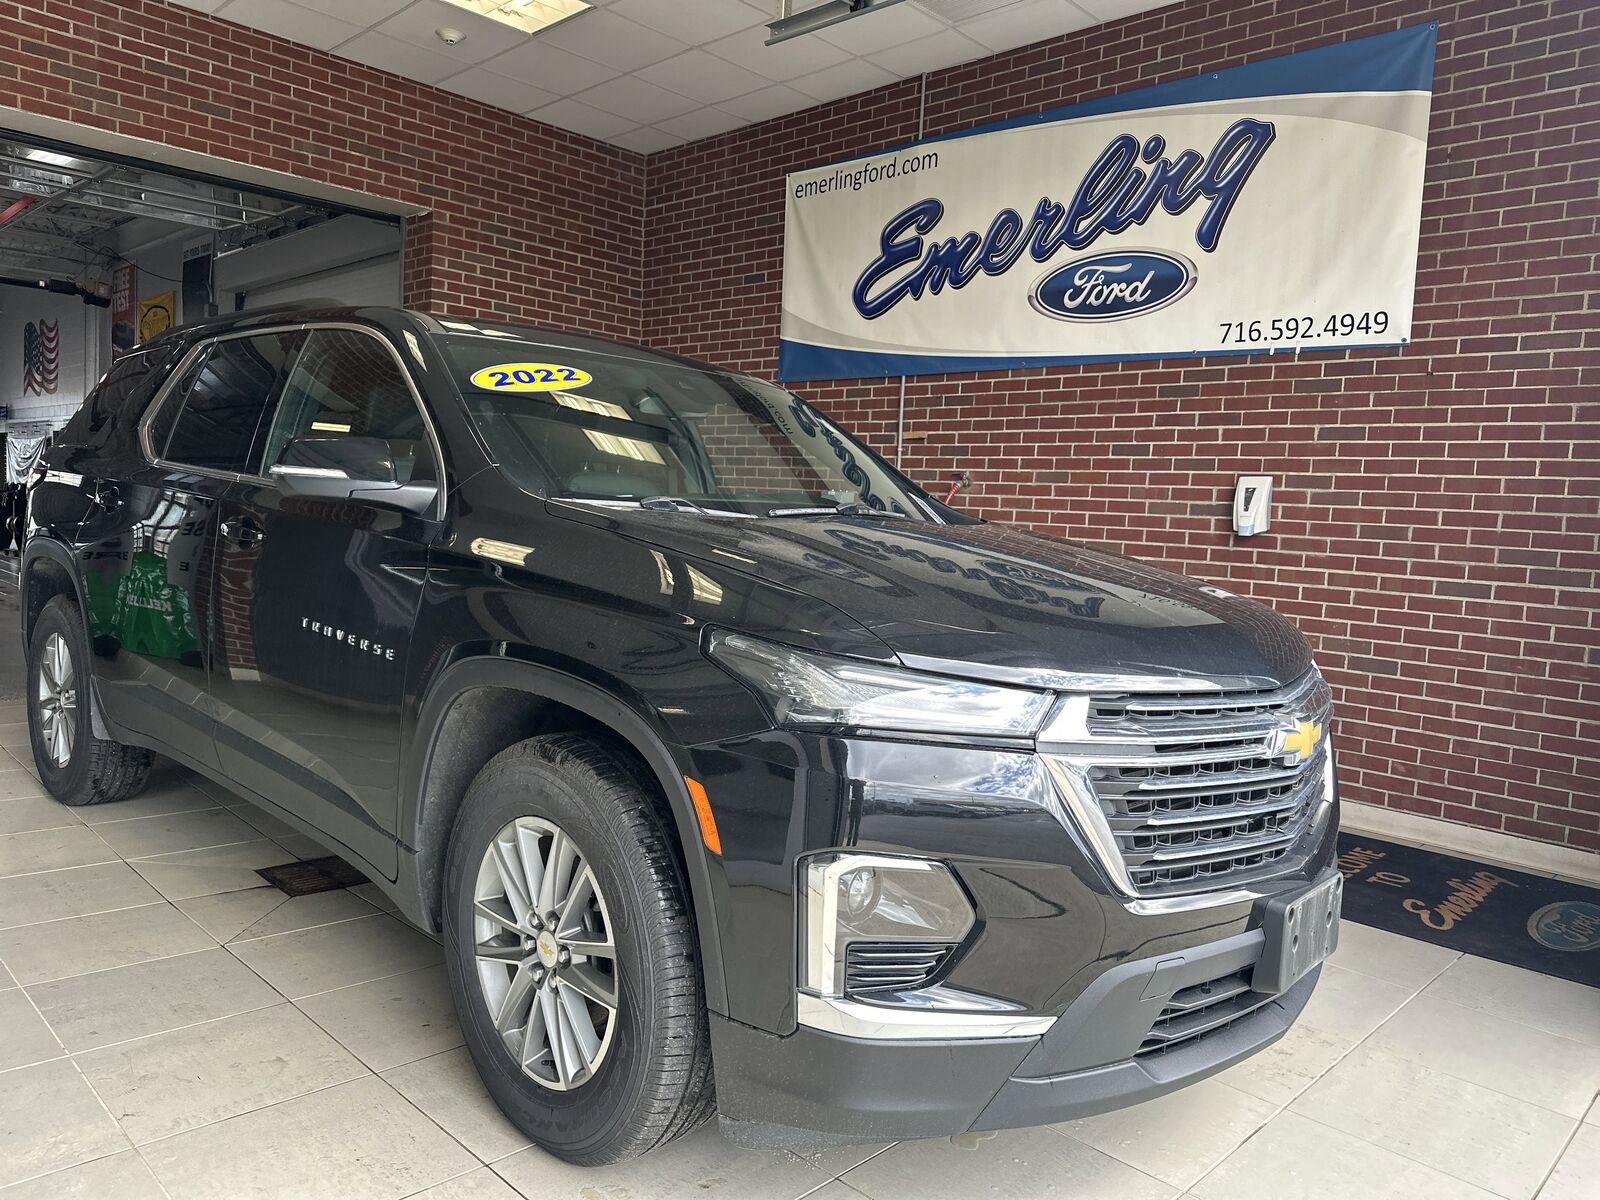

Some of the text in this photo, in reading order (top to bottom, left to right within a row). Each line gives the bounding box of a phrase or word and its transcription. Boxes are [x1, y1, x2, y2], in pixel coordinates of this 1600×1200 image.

[795, 151, 939, 199] emerlingford.com
[850, 117, 1277, 321] Emerling
[1063, 263, 1153, 309] Ford
[1219, 311, 1390, 345] 716.592.4949
[488, 368, 581, 387] 2022
[301, 616, 396, 661] TRAVERSE
[1337, 847, 1387, 880] COME
[1366, 871, 1411, 888] TO
[1402, 870, 1519, 930] Emerling
